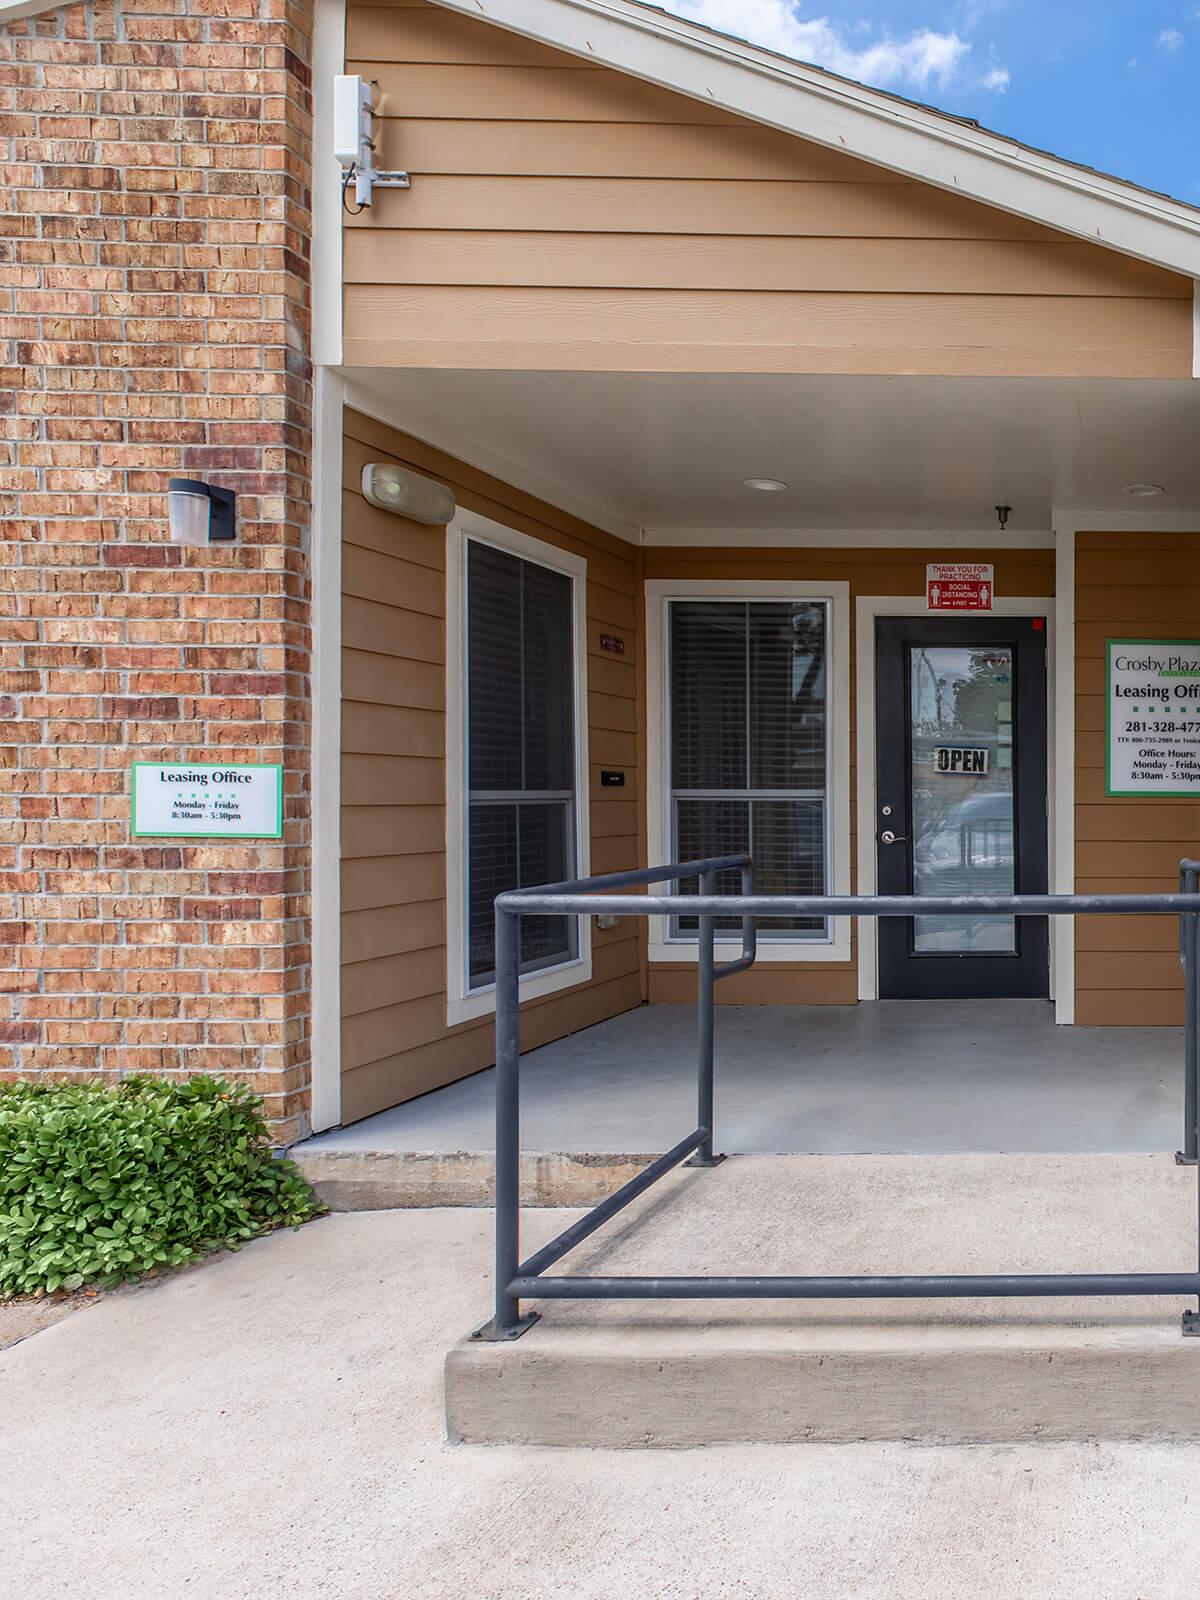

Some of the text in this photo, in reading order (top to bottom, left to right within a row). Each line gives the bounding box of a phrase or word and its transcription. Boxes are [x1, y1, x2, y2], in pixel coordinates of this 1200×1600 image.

[1115, 656, 1165, 676] Crosby
[1115, 684, 1170, 702] Leasing
[1139, 749, 1196, 758] Office Hours:
[938, 749, 985, 772] OPEN
[1133, 760, 1167, 770] Monday
[1176, 761, 1200, 770] Friday
[161, 771, 252, 786] Leasing Office
[1131, 772, 1163, 780] 8:30am
[173, 801, 206, 810] Monday
[214, 801, 239, 810] Friday
[172, 812, 203, 820] 8:30am
[210, 812, 241, 821] 5:30pm
